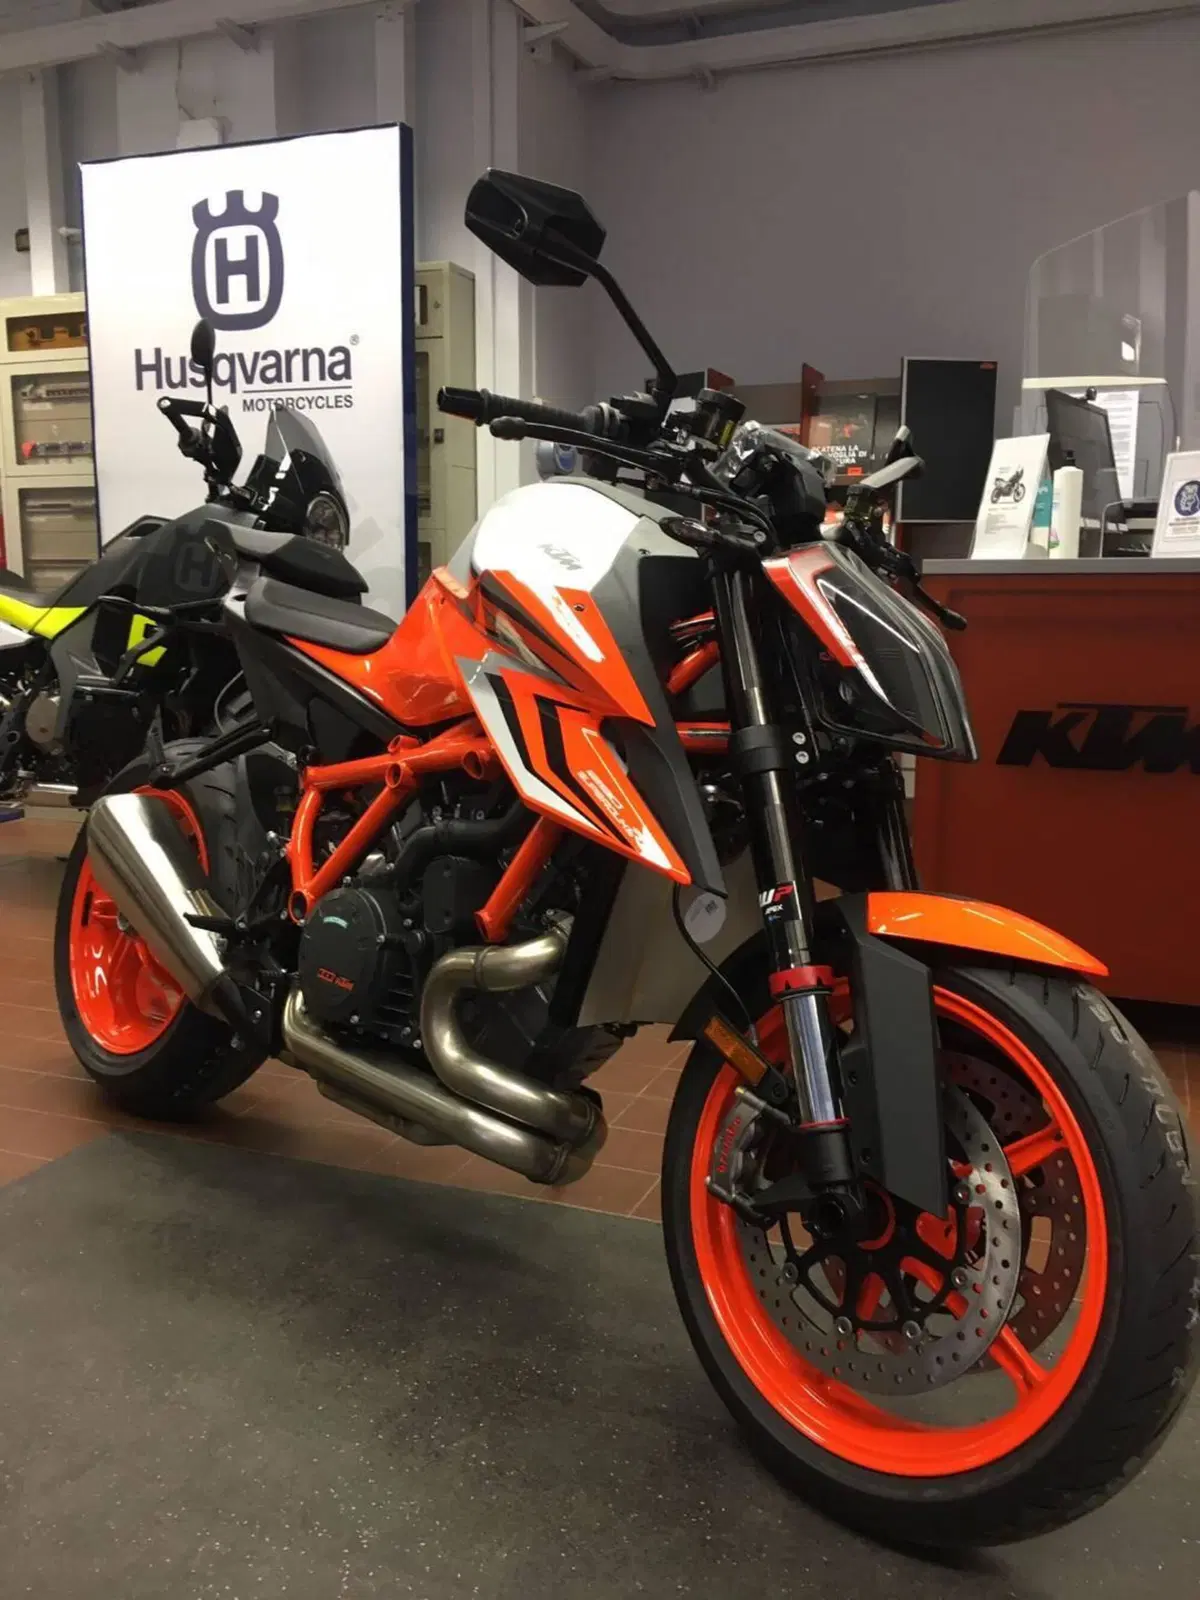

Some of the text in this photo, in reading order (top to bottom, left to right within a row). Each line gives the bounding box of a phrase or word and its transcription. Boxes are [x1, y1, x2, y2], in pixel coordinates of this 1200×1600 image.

[214, 235, 261, 304] H
[134, 345, 353, 394] Husqvarna
[242, 395, 353, 412] MOTORCYCLES
[536, 543, 583, 571] KTM
[996, 703, 1200, 774] KTM
[759, 884, 795, 908] WP
